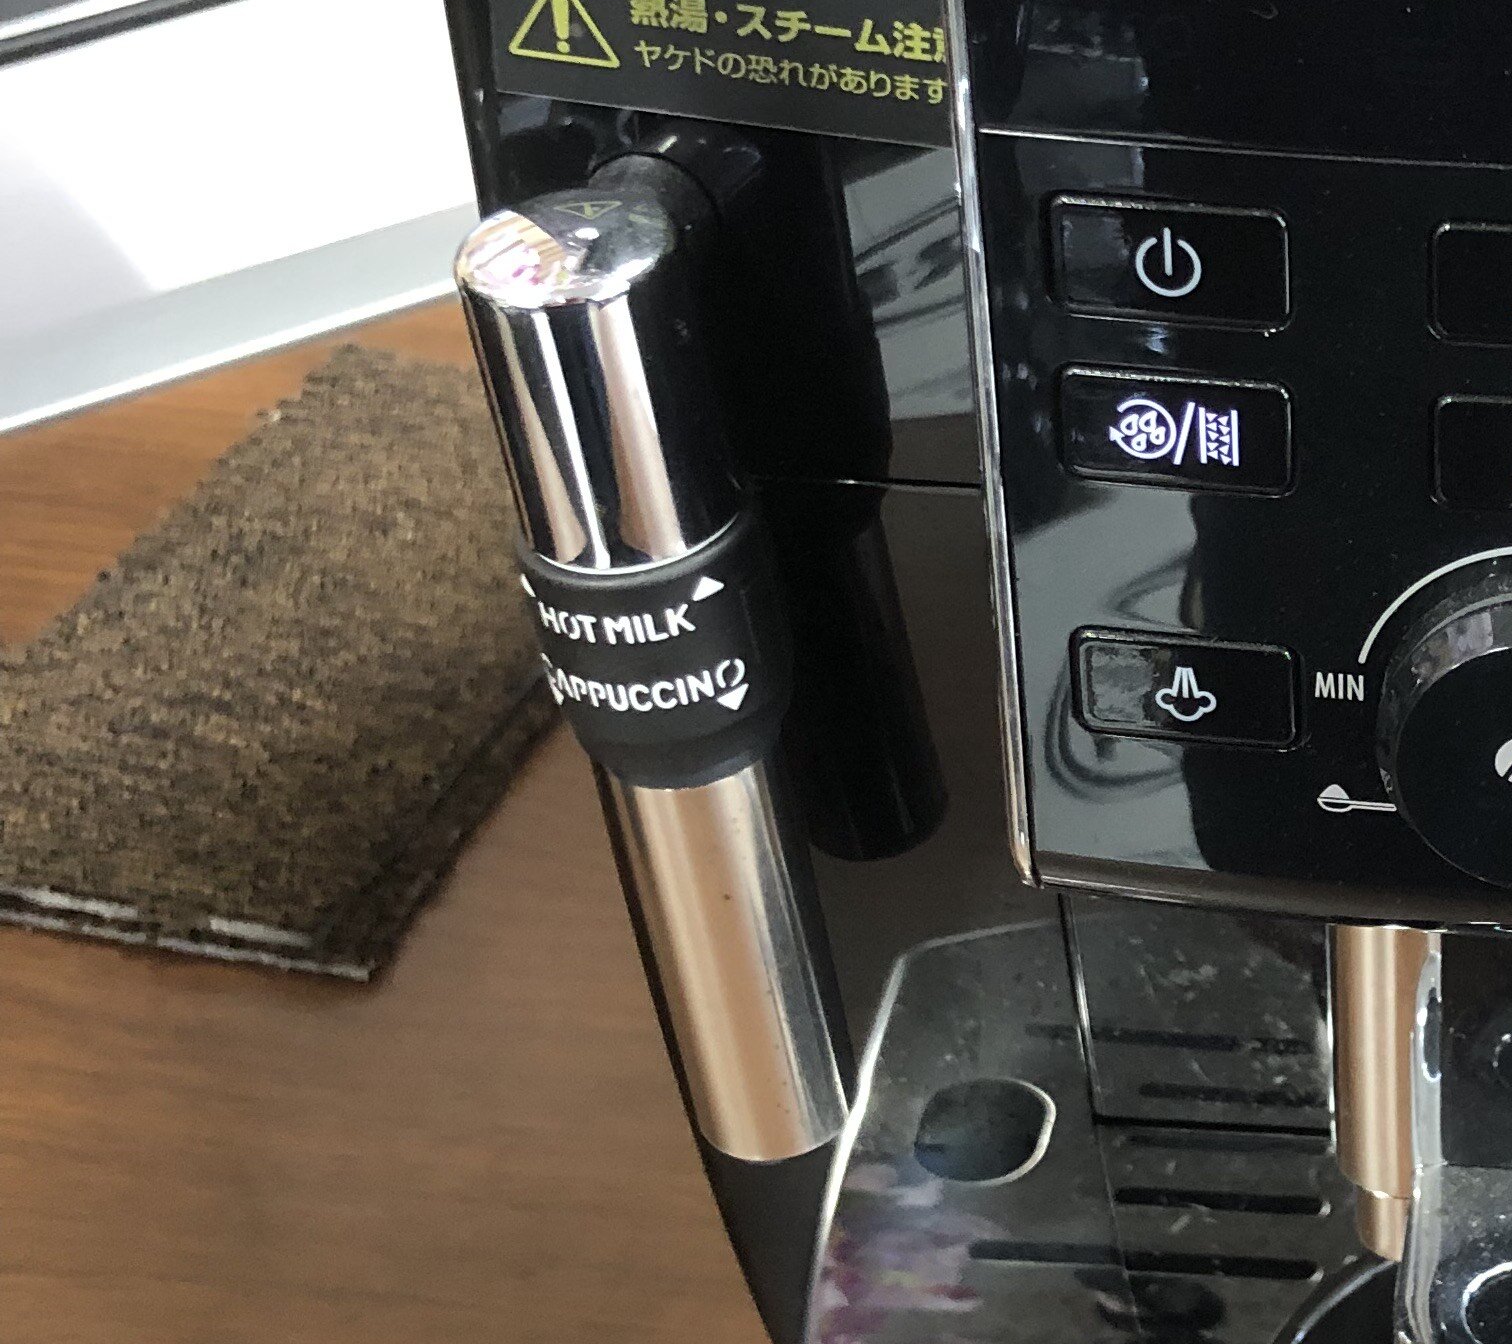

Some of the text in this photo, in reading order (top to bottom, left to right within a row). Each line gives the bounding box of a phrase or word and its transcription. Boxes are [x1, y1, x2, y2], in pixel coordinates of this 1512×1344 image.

[634, 39, 948, 105] ヤケドの恐れがあります
[536, 601, 696, 645] HOT MILK
[1314, 670, 1367, 702] MIN
